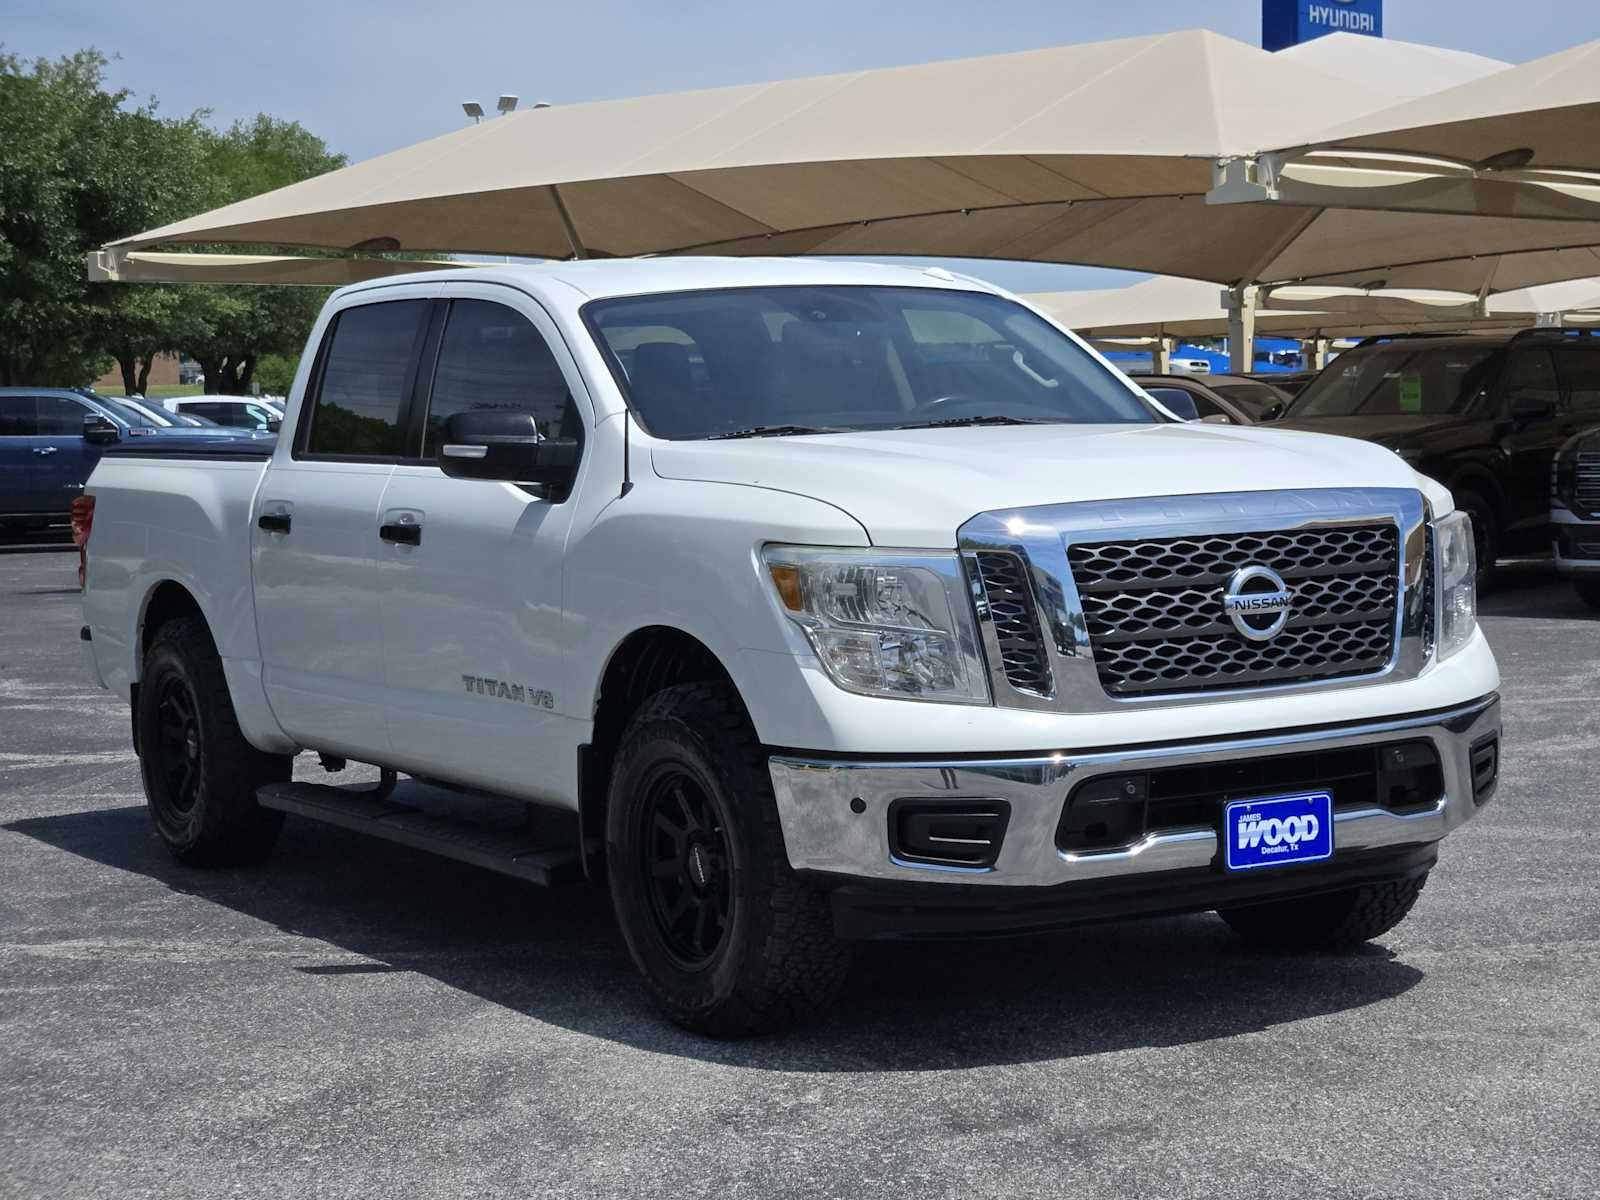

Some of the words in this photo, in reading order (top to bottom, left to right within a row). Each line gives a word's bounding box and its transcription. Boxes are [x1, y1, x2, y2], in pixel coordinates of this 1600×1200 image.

[1309, 4, 1374, 31] HYUNDAI
[1234, 596, 1289, 610] NISSAN
[462, 674, 525, 703] TITAN
[1238, 813, 1262, 823] JAMES
[1238, 814, 1319, 849] WOOD
